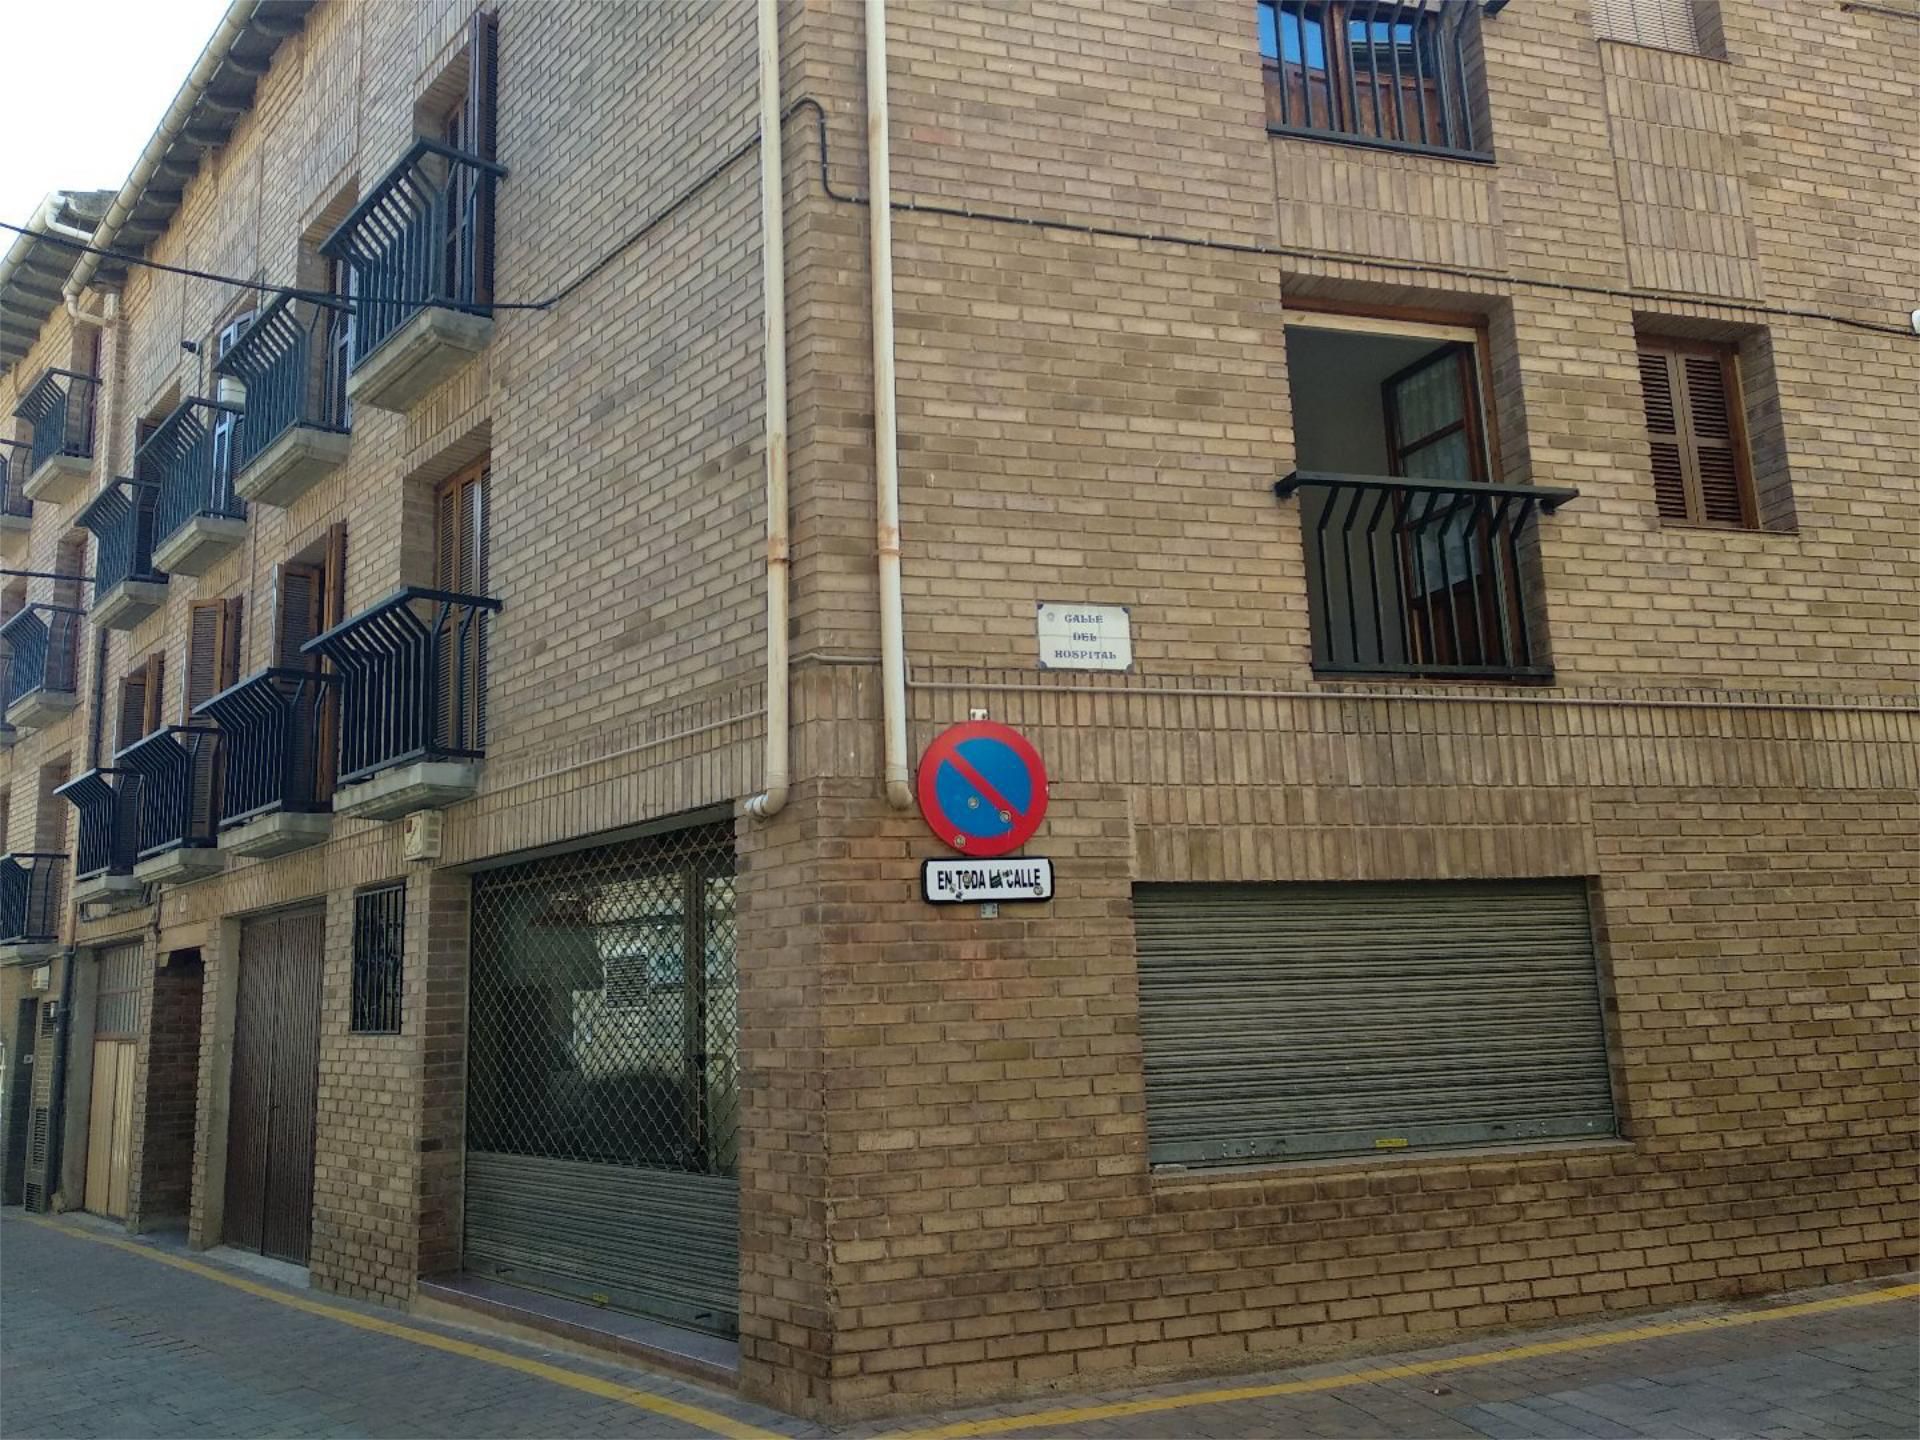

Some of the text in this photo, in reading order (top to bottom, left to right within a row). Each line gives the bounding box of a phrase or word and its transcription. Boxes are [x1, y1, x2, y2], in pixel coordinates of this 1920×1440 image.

[1073, 632, 1097, 641] DEL
[1054, 650, 1117, 660] HOSPITAL
[937, 870, 952, 890] EN
[1007, 868, 1041, 889] CALLE
